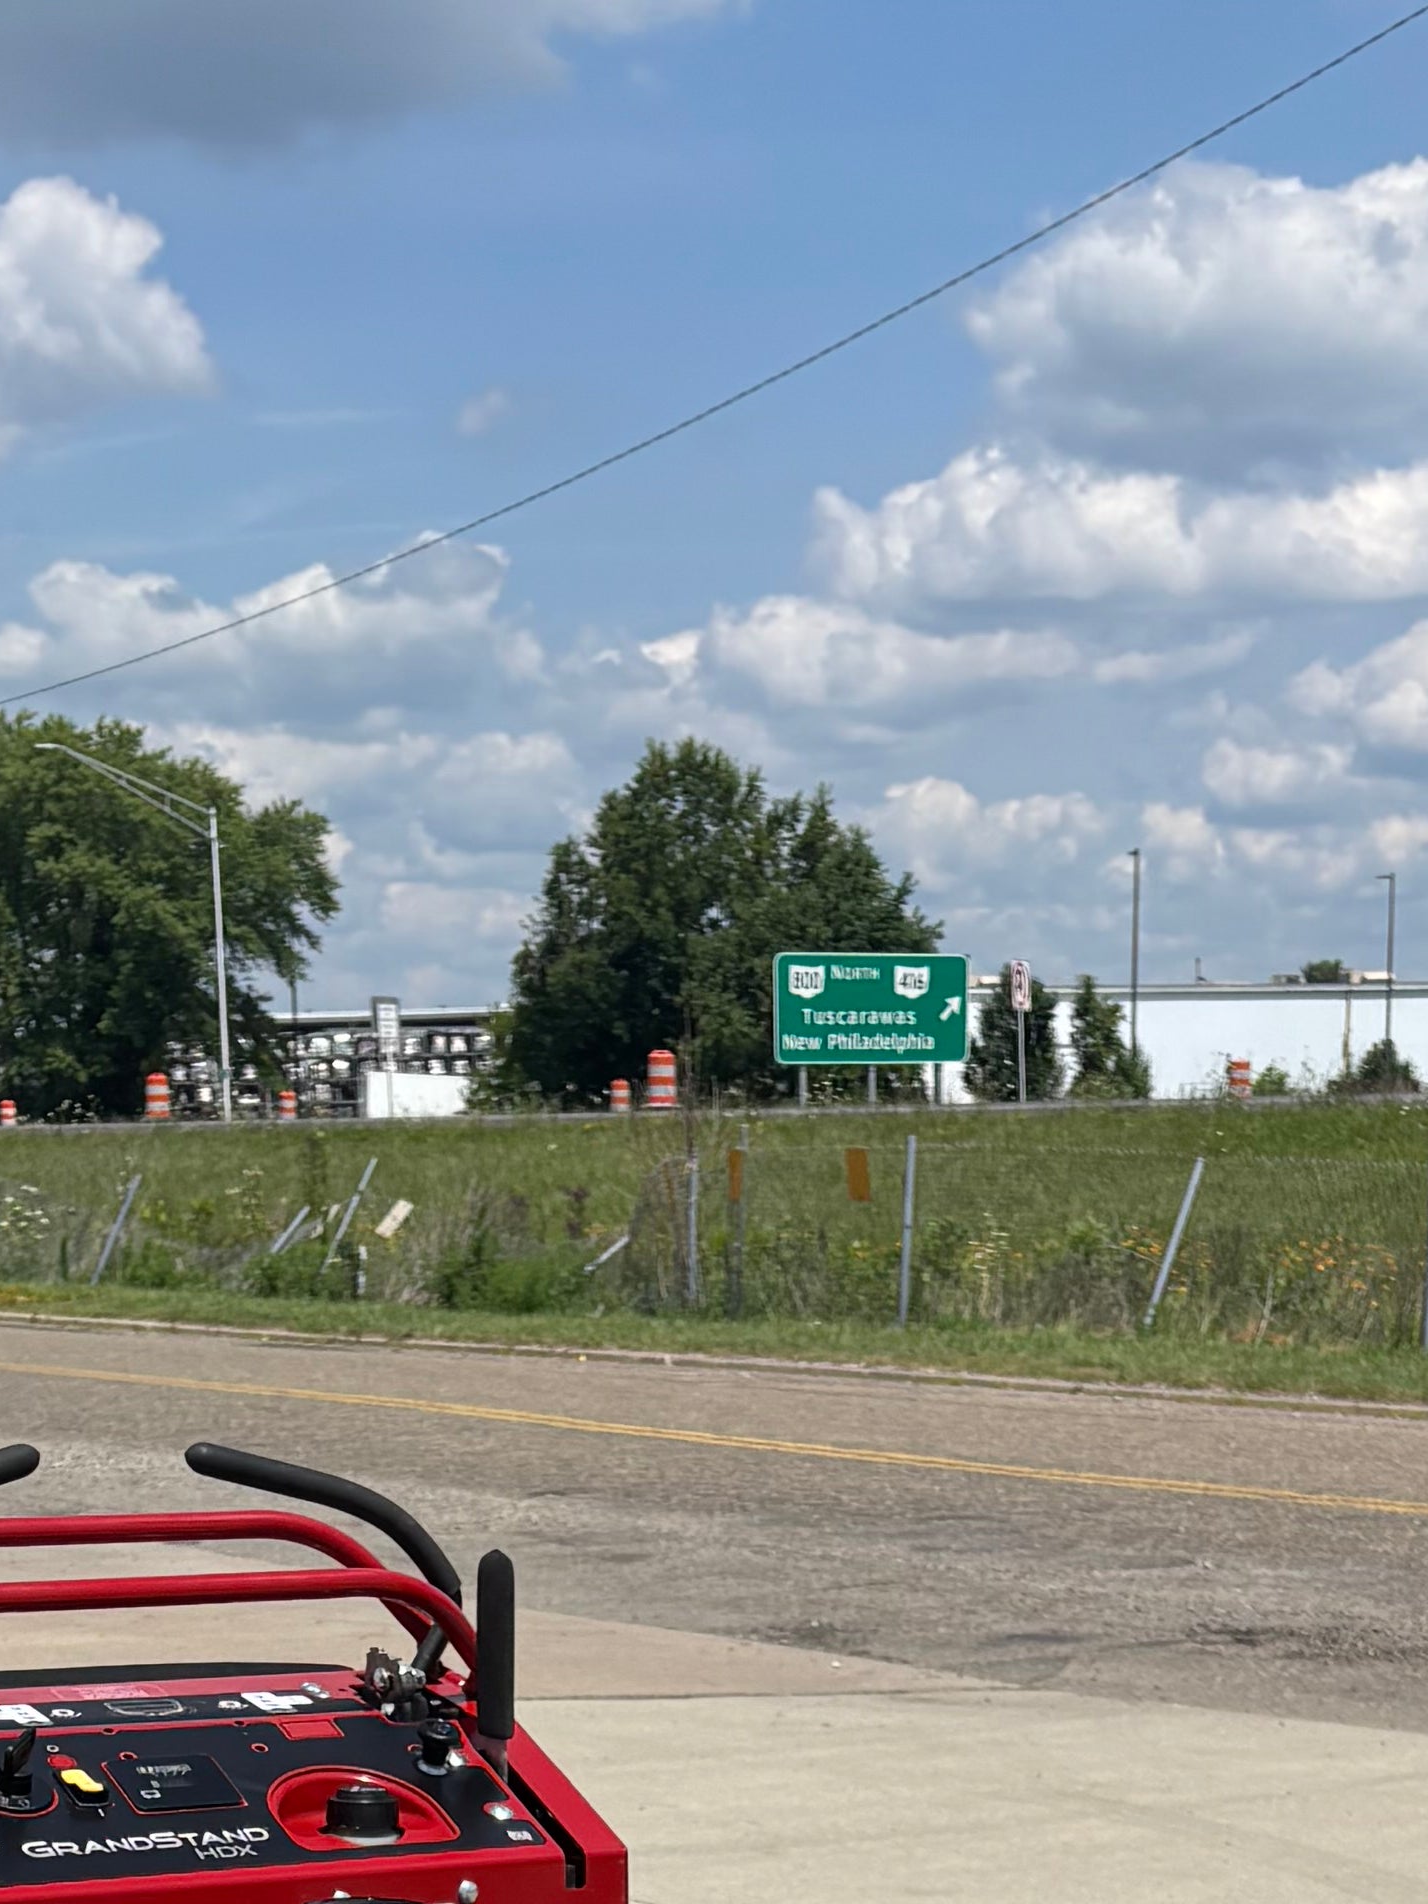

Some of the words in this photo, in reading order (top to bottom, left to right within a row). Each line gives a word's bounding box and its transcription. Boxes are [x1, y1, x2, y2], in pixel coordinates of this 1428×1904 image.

[801, 1008, 917, 1025] Tuscarawas
[782, 1034, 822, 1050] New
[827, 1033, 936, 1054] Philadelphia
[195, 1844, 259, 1860] HDX
